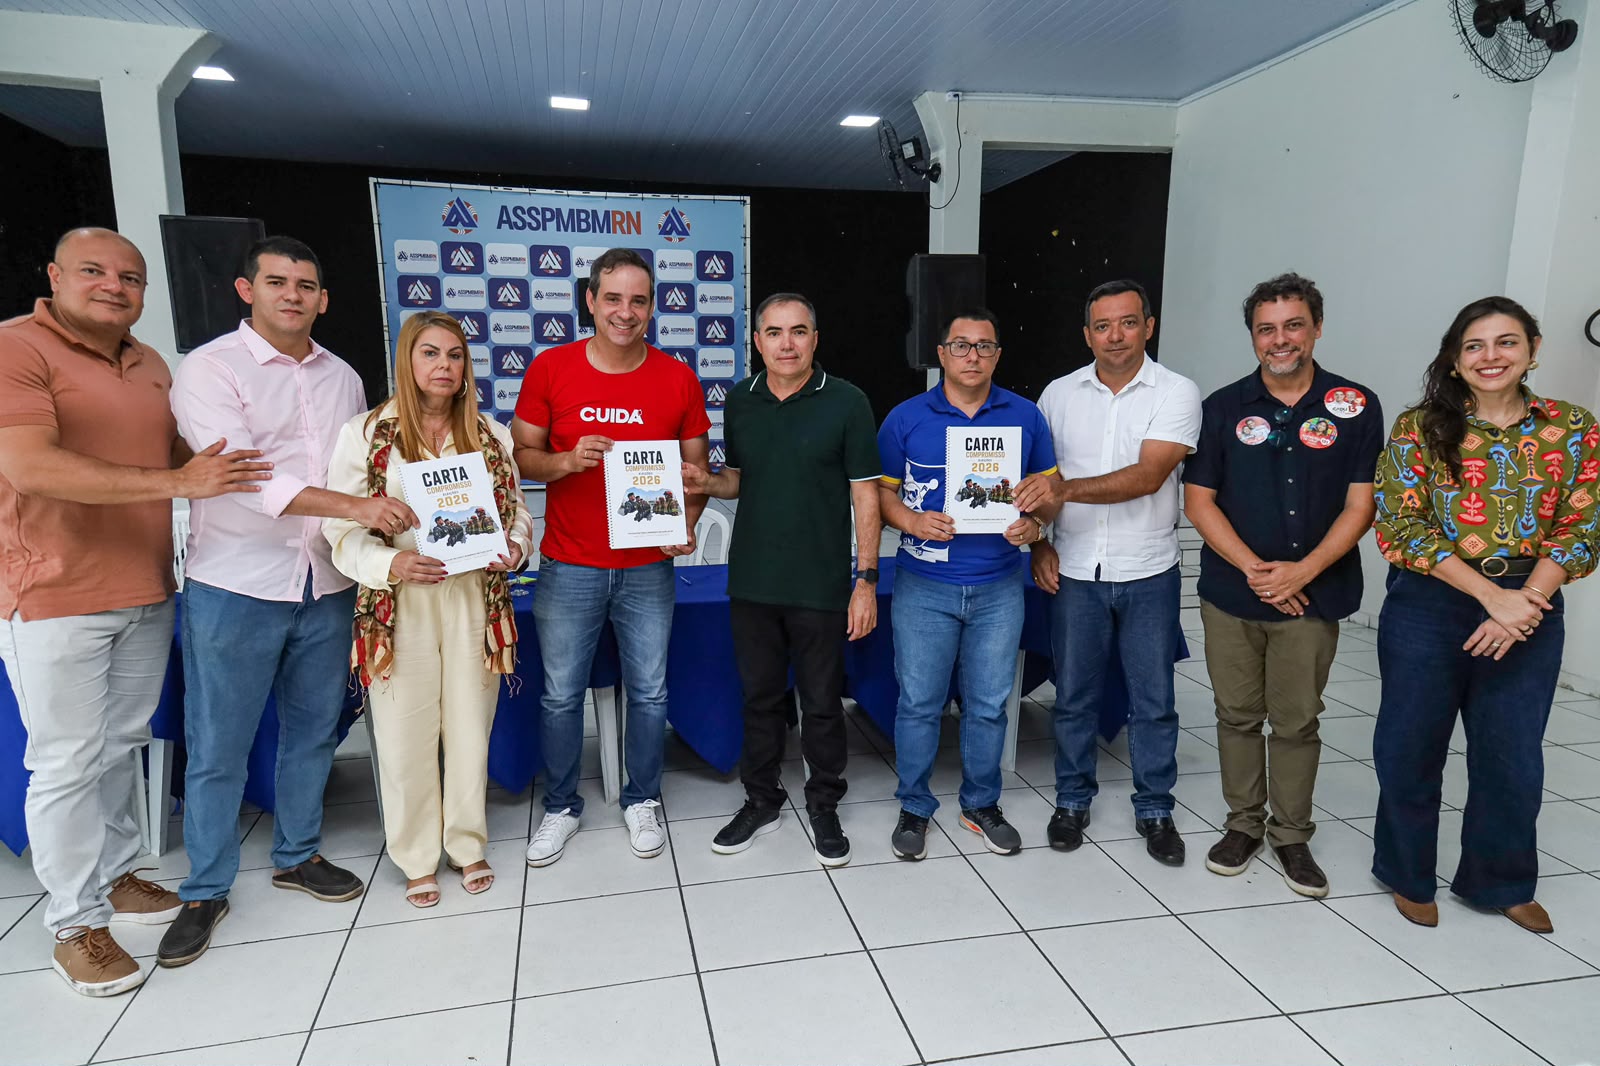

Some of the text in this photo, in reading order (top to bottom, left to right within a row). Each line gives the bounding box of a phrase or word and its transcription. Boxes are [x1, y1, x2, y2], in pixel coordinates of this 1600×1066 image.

[497, 205, 642, 235] ASSPMBMRN
[579, 406, 644, 425] CUIDA
[965, 437, 1004, 451] CARTA
[623, 450, 664, 465] CARTA
[625, 464, 666, 472] COMPROMISSO
[971, 462, 999, 472] 2026
[422, 466, 469, 487] CARTA
[632, 475, 661, 486] 2026
[426, 480, 472, 495] COMPROMISSO
[437, 493, 469, 508] 2026
